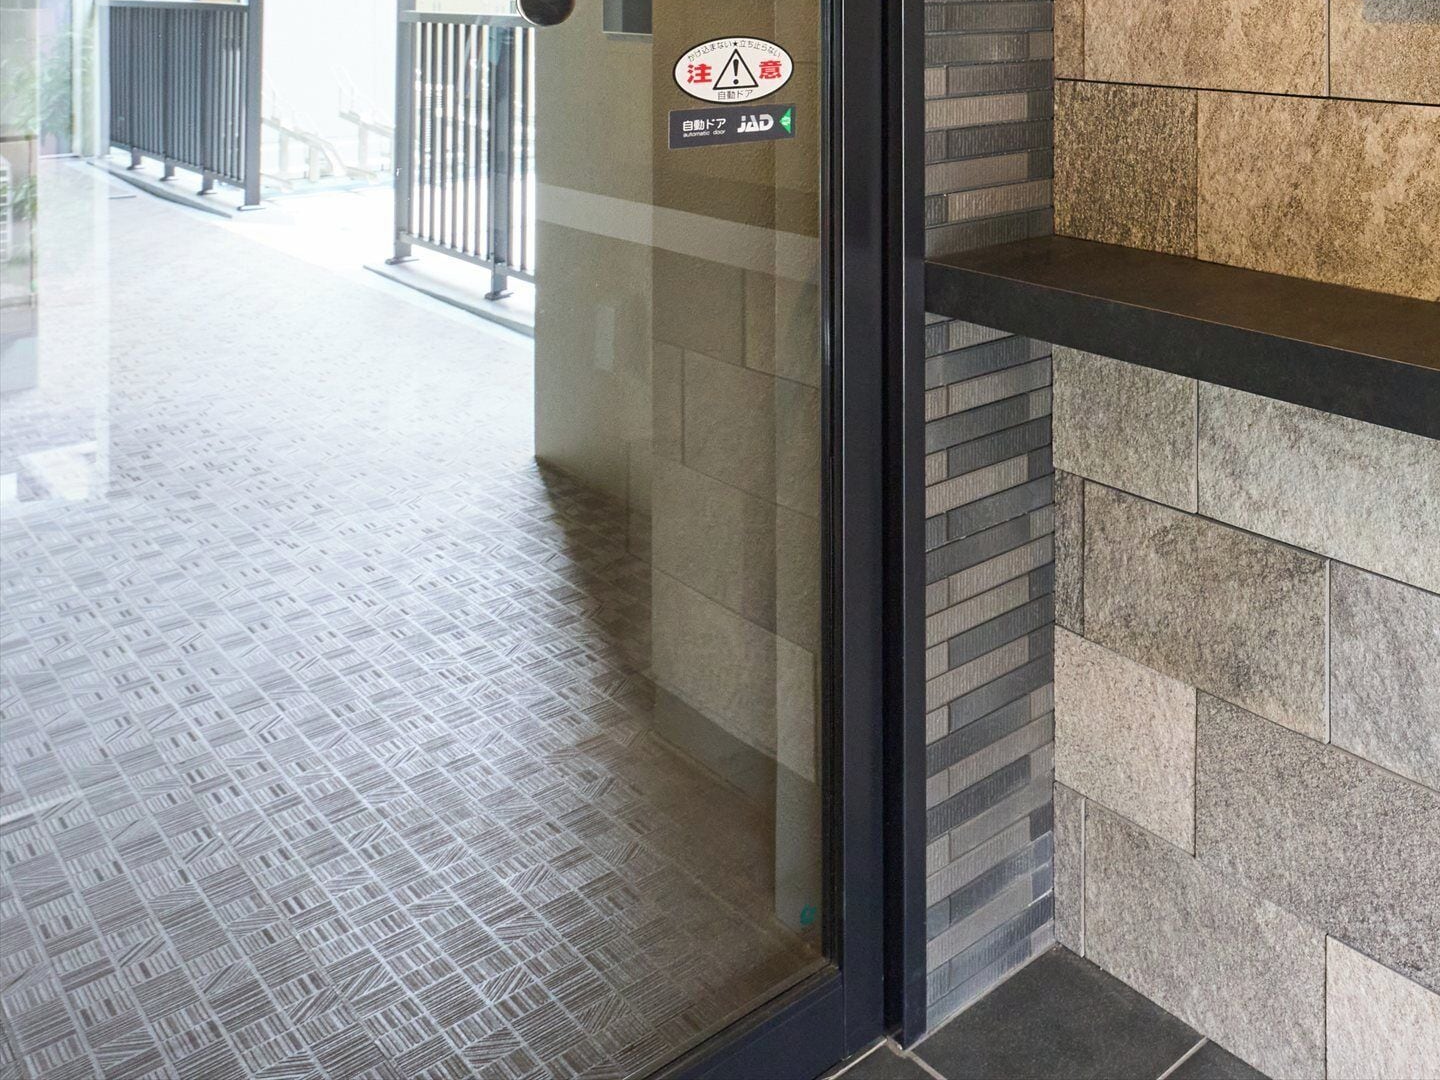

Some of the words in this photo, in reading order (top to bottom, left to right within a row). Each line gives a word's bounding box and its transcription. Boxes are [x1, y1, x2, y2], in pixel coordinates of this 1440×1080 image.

[718, 89, 753, 100] 自動ドア
[683, 118, 727, 132] 自動ドア
[683, 130, 711, 138] automatic
